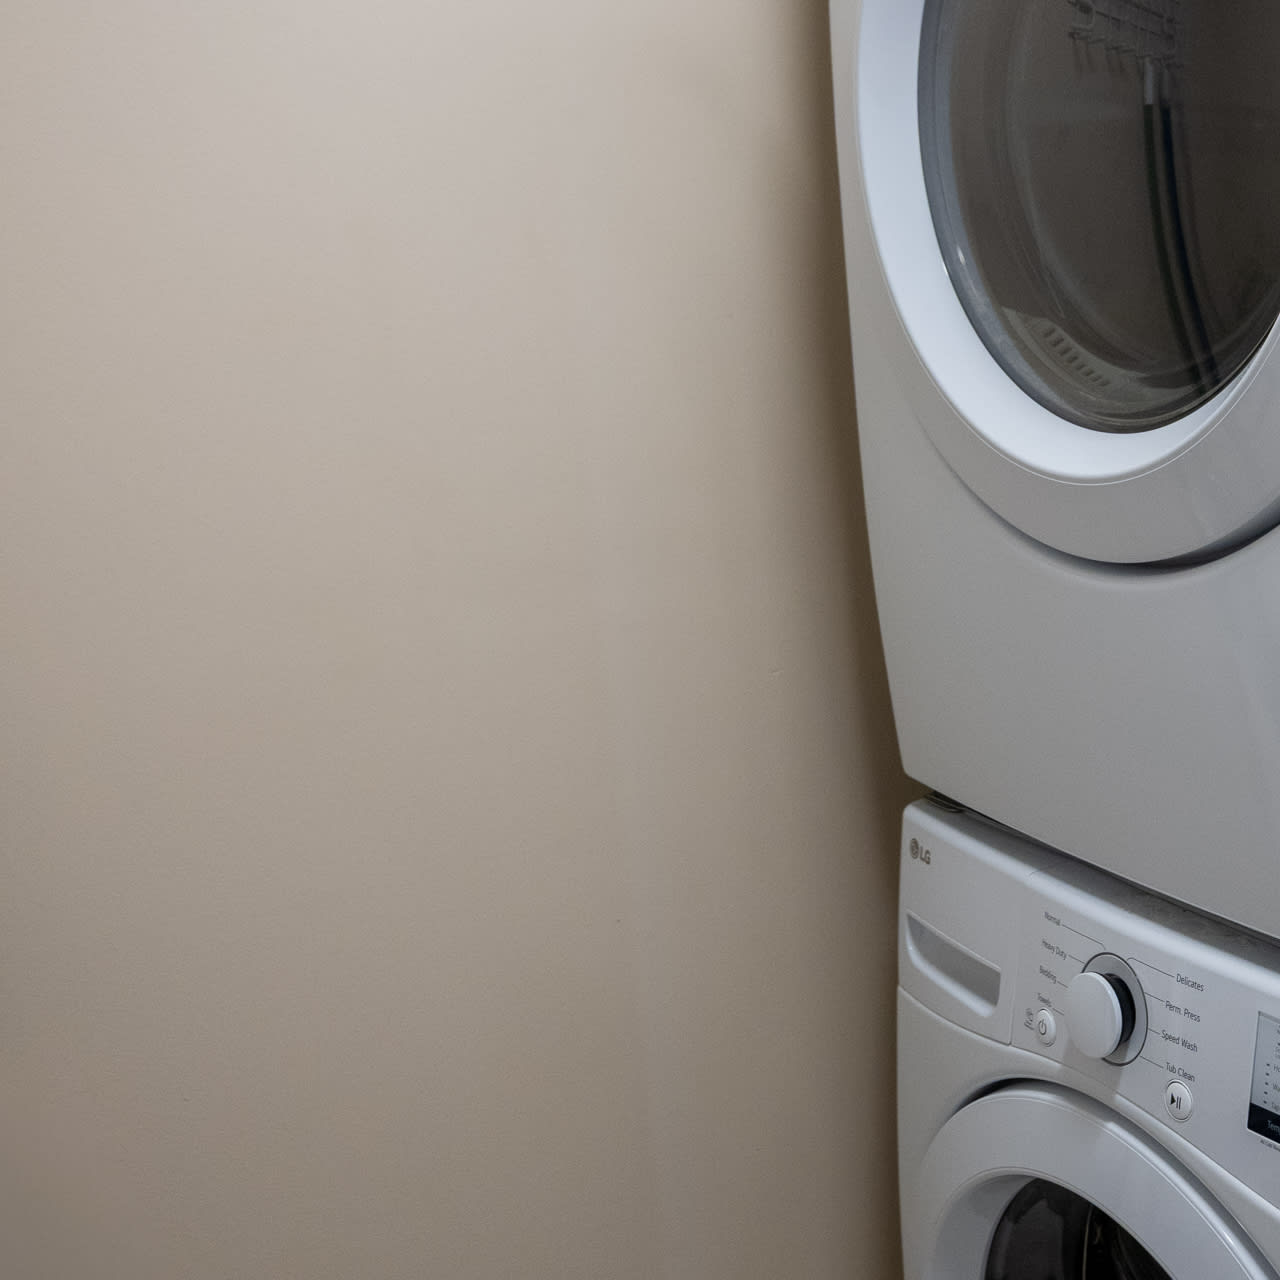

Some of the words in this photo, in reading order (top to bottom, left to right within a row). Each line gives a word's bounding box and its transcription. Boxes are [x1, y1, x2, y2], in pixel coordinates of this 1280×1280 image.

[1176, 973, 1204, 992] Delicates
[1165, 1000, 1183, 1016] Perm.
[1183, 1008, 1201, 1023] Press
[1161, 1029, 1180, 1045] Speed
[1181, 1037, 1198, 1053] Wash
[1165, 1061, 1177, 1075] Tub
[1177, 1067, 1195, 1082] Clean
